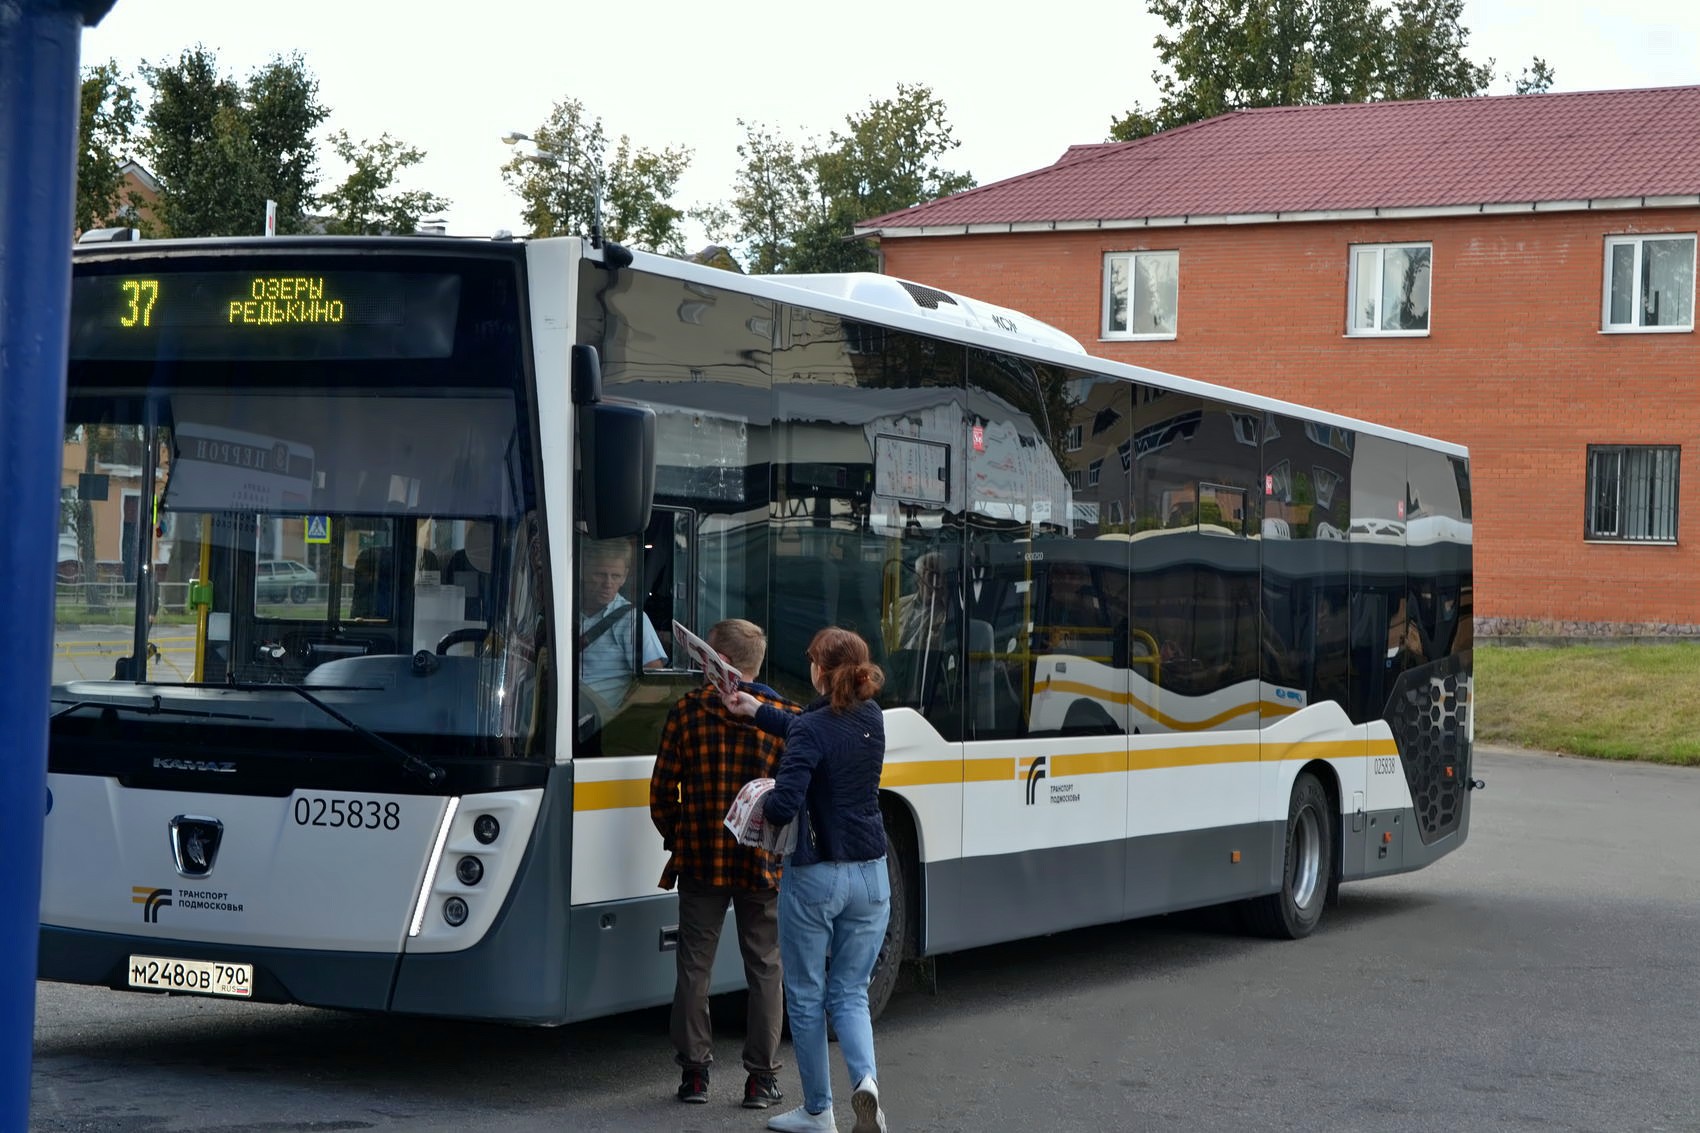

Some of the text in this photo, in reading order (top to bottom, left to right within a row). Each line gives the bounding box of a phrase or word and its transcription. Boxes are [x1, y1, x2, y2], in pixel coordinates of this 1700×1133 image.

[252, 278, 323, 300] ОЗЕРЫ
[121, 280, 159, 327] 37
[229, 301, 344, 325] РЕДЬКИНО
[153, 757, 237, 773] KAMAZ
[294, 797, 401, 831] 025838
[178, 889, 228, 900] ТРАНСПОРТ
[178, 899, 244, 912] ПОДМОСКОВЬЯ
[215, 965, 246, 985] 790
[221, 984, 237, 993] RUS
